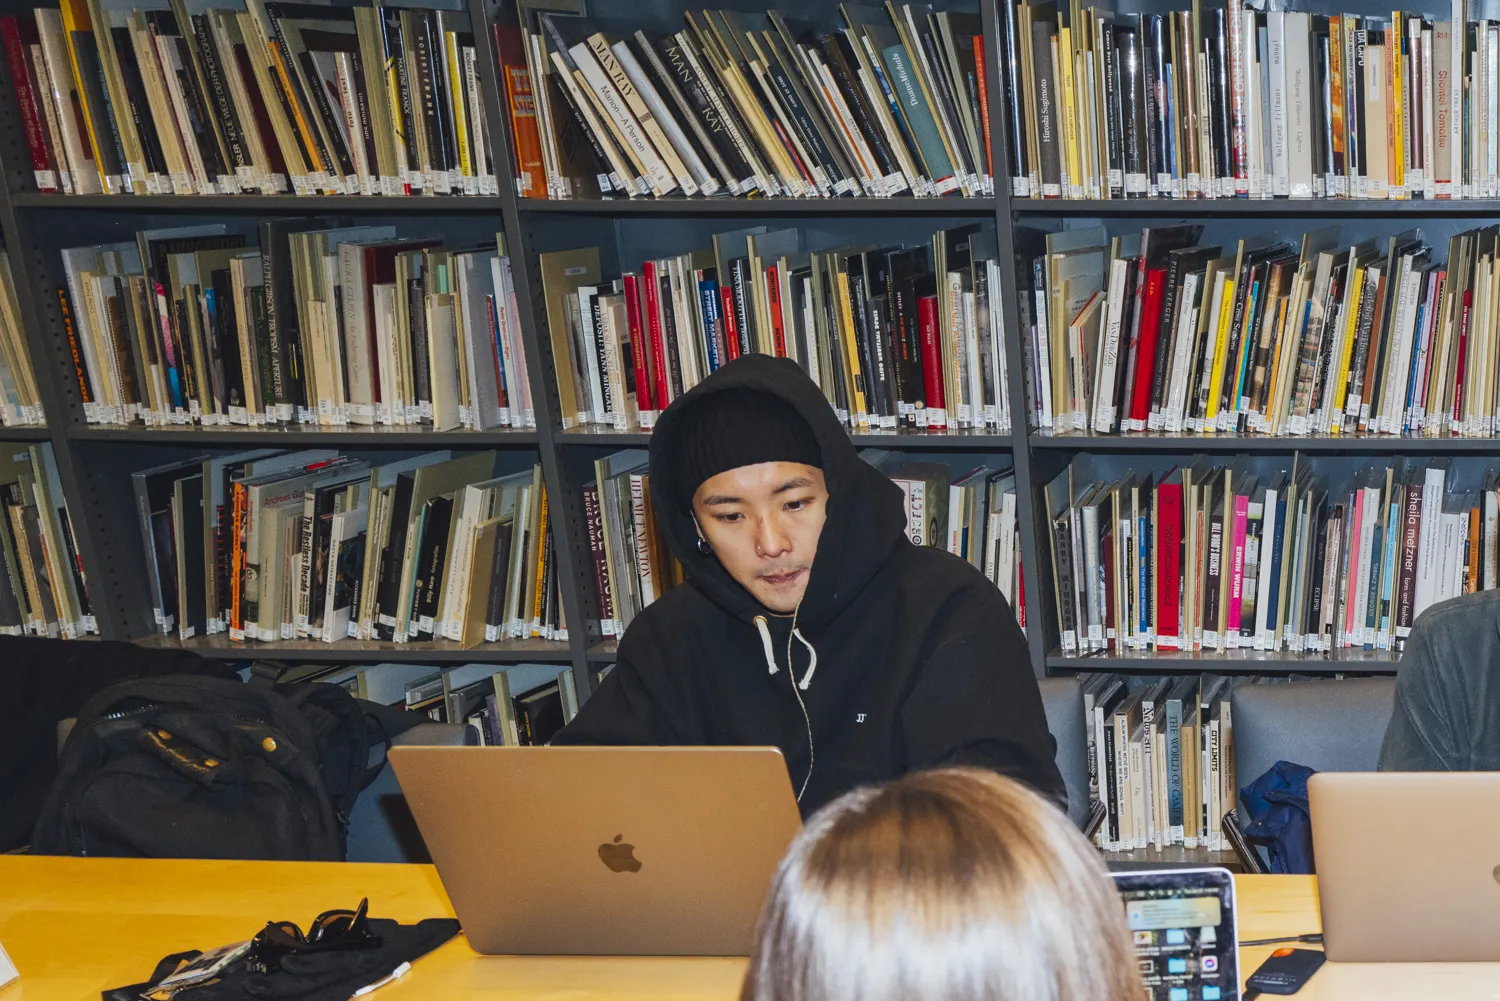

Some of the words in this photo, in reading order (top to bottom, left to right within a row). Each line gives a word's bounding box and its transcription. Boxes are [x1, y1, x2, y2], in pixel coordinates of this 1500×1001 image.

[1357, 32, 1365, 45] DA
[396, 57, 407, 87] MARTINE
[417, 36, 429, 74] ROBERT
[424, 78, 434, 117] FRANK
[611, 73, 635, 98] RAY
[401, 88, 410, 115] FRANCK
[664, 46, 693, 83] MAN
[701, 107, 723, 133] RAY
[1040, 78, 1049, 115] Sugimoto
[1438, 70, 1447, 106] Shomei
[625, 125, 646, 152] Person
[1042, 115, 1051, 143] Hiroshi
[1438, 109, 1447, 148] Tomatsu
[1168, 261, 1178, 288] PIERRE
[1185, 281, 1193, 300] Present
[1363, 283, 1376, 320] Carleton
[704, 290, 714, 322] STREET
[1164, 292, 1174, 324] VERGER
[1234, 302, 1244, 322] Cross
[57, 289, 69, 316] LEE
[63, 317, 89, 403] FRIEDLANDE
[271, 357, 283, 398] APERTURE
[583, 491, 593, 517] BRUCE
[1406, 491, 1421, 525] sheila
[303, 516, 313, 530] The
[587, 519, 597, 552] NAUMAN
[301, 531, 311, 564] Restless
[1234, 546, 1243, 572] ERWIN
[1405, 528, 1417, 572] metzner
[300, 564, 310, 593] Decade
[1233, 573, 1242, 599] WURM
[1371, 562, 1379, 585] ZIMBEL
[1403, 577, 1412, 591] form
[1313, 587, 1321, 612] ECLIPSE
[1369, 594, 1377, 617] GEORGE
[1402, 592, 1410, 605] and
[1400, 605, 1409, 627] fashion
[1169, 715, 1178, 734] THE
[1170, 739, 1179, 772] WORLD
[1171, 774, 1180, 787] OF
[1172, 789, 1182, 825] CAMER
